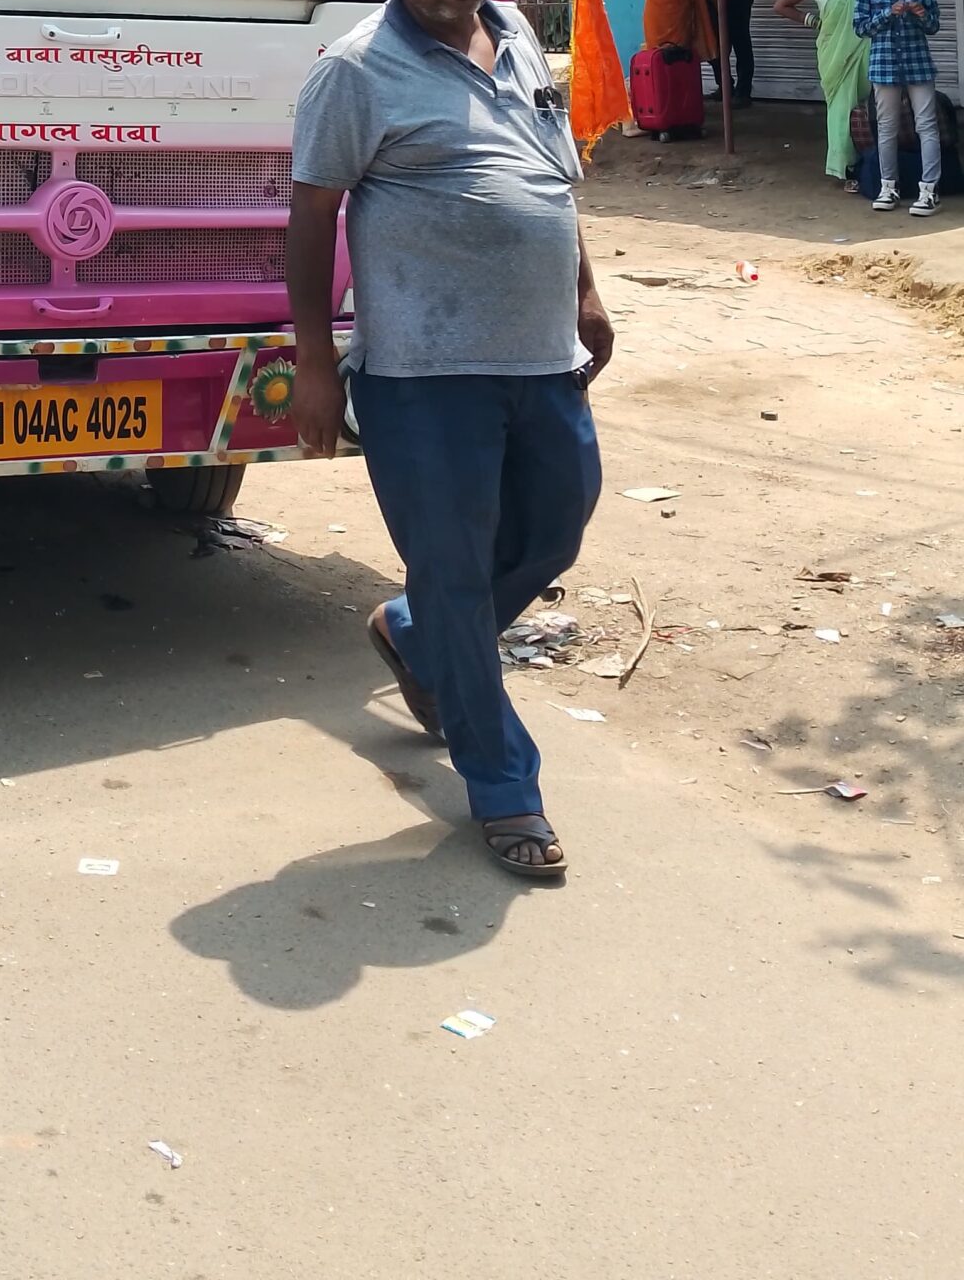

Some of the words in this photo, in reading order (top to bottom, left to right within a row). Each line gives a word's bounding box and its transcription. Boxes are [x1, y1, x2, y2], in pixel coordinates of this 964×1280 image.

[5, 47, 62, 65] बाबा
[69, 44, 203, 72] बासुकीनाथ
[79, 74, 256, 99] LEYLAND
[90, 124, 162, 143] बाबा
[70, 210, 90, 230] L
[13, 398, 79, 445] 04AC
[86, 396, 148, 440] 4025
